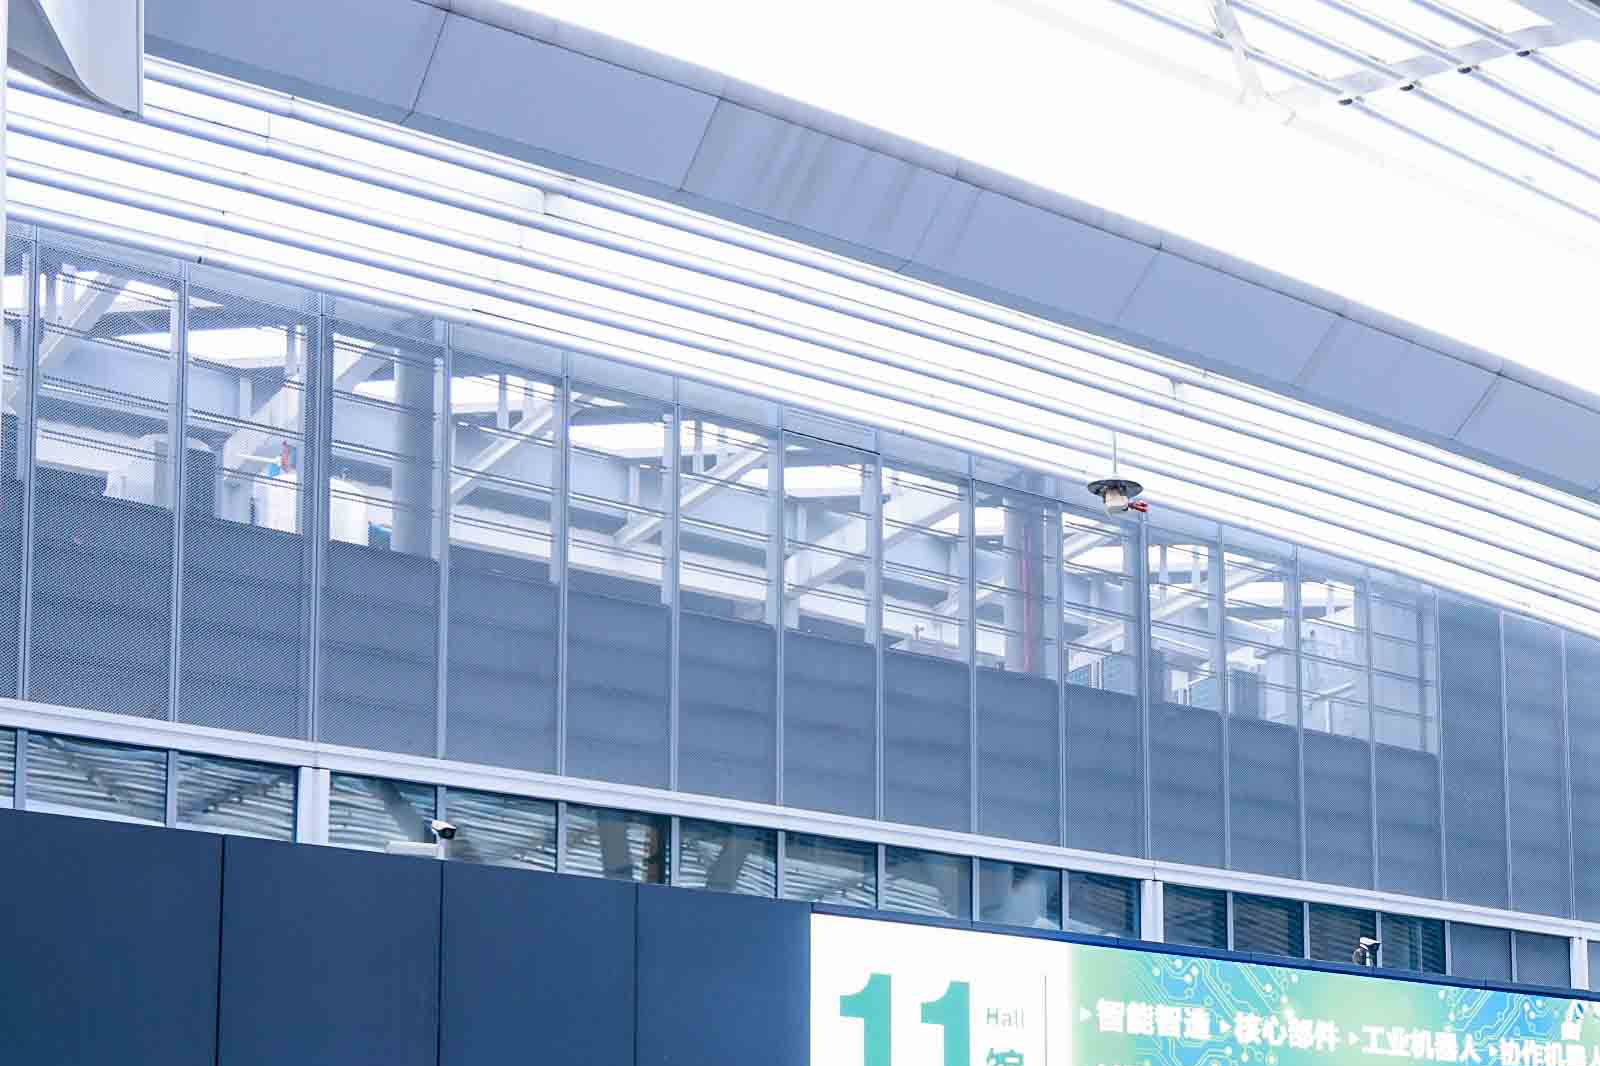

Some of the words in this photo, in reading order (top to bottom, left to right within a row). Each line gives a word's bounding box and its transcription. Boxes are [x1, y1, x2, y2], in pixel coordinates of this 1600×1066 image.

[986, 1007, 1025, 1028] Hall
[1235, 1012, 1339, 1051] 核心部件
[1362, 1024, 1481, 1063] 工业机器人
